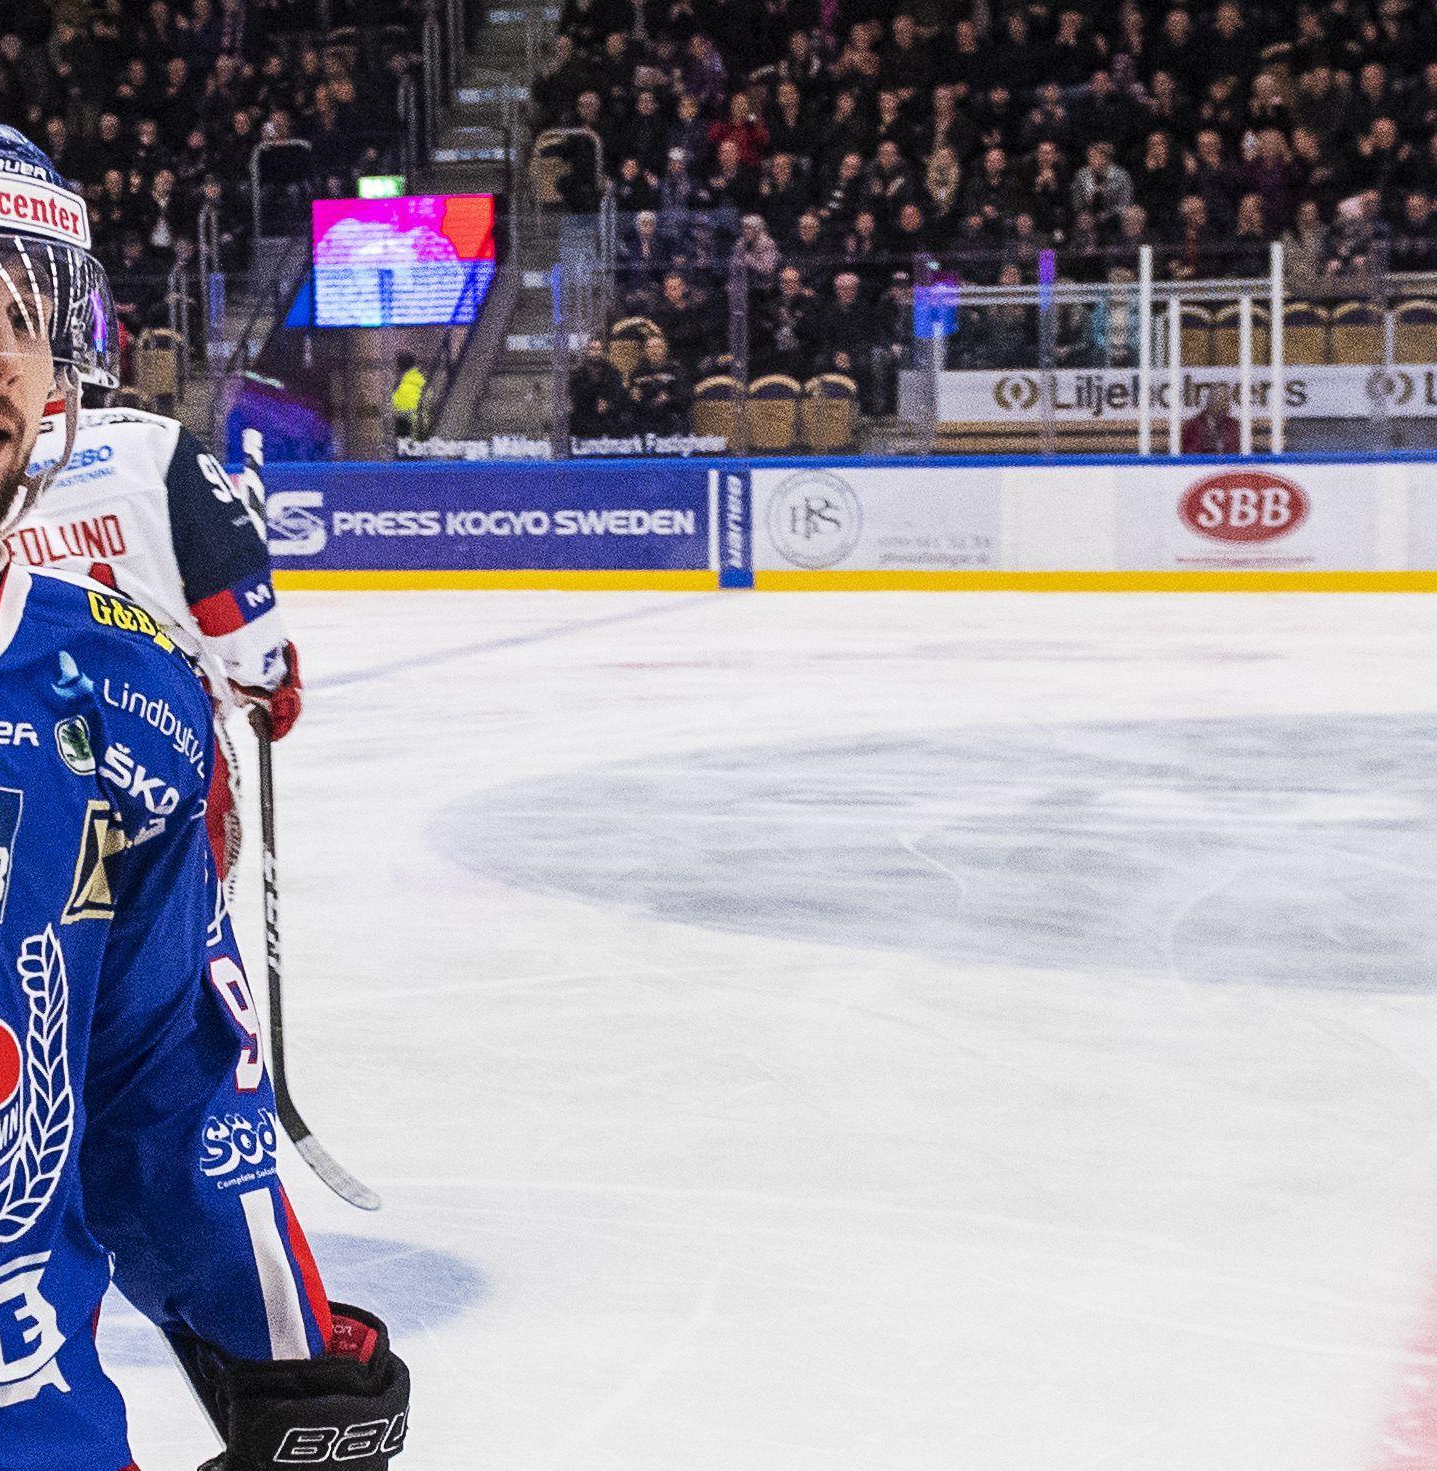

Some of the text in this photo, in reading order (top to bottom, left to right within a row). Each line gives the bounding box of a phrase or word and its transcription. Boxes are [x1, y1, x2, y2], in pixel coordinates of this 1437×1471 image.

[333, 508, 695, 538] PRESS KOGYO SWEDEN
[1197, 488, 1294, 529] SBB
[87, 590, 159, 637] G&B
